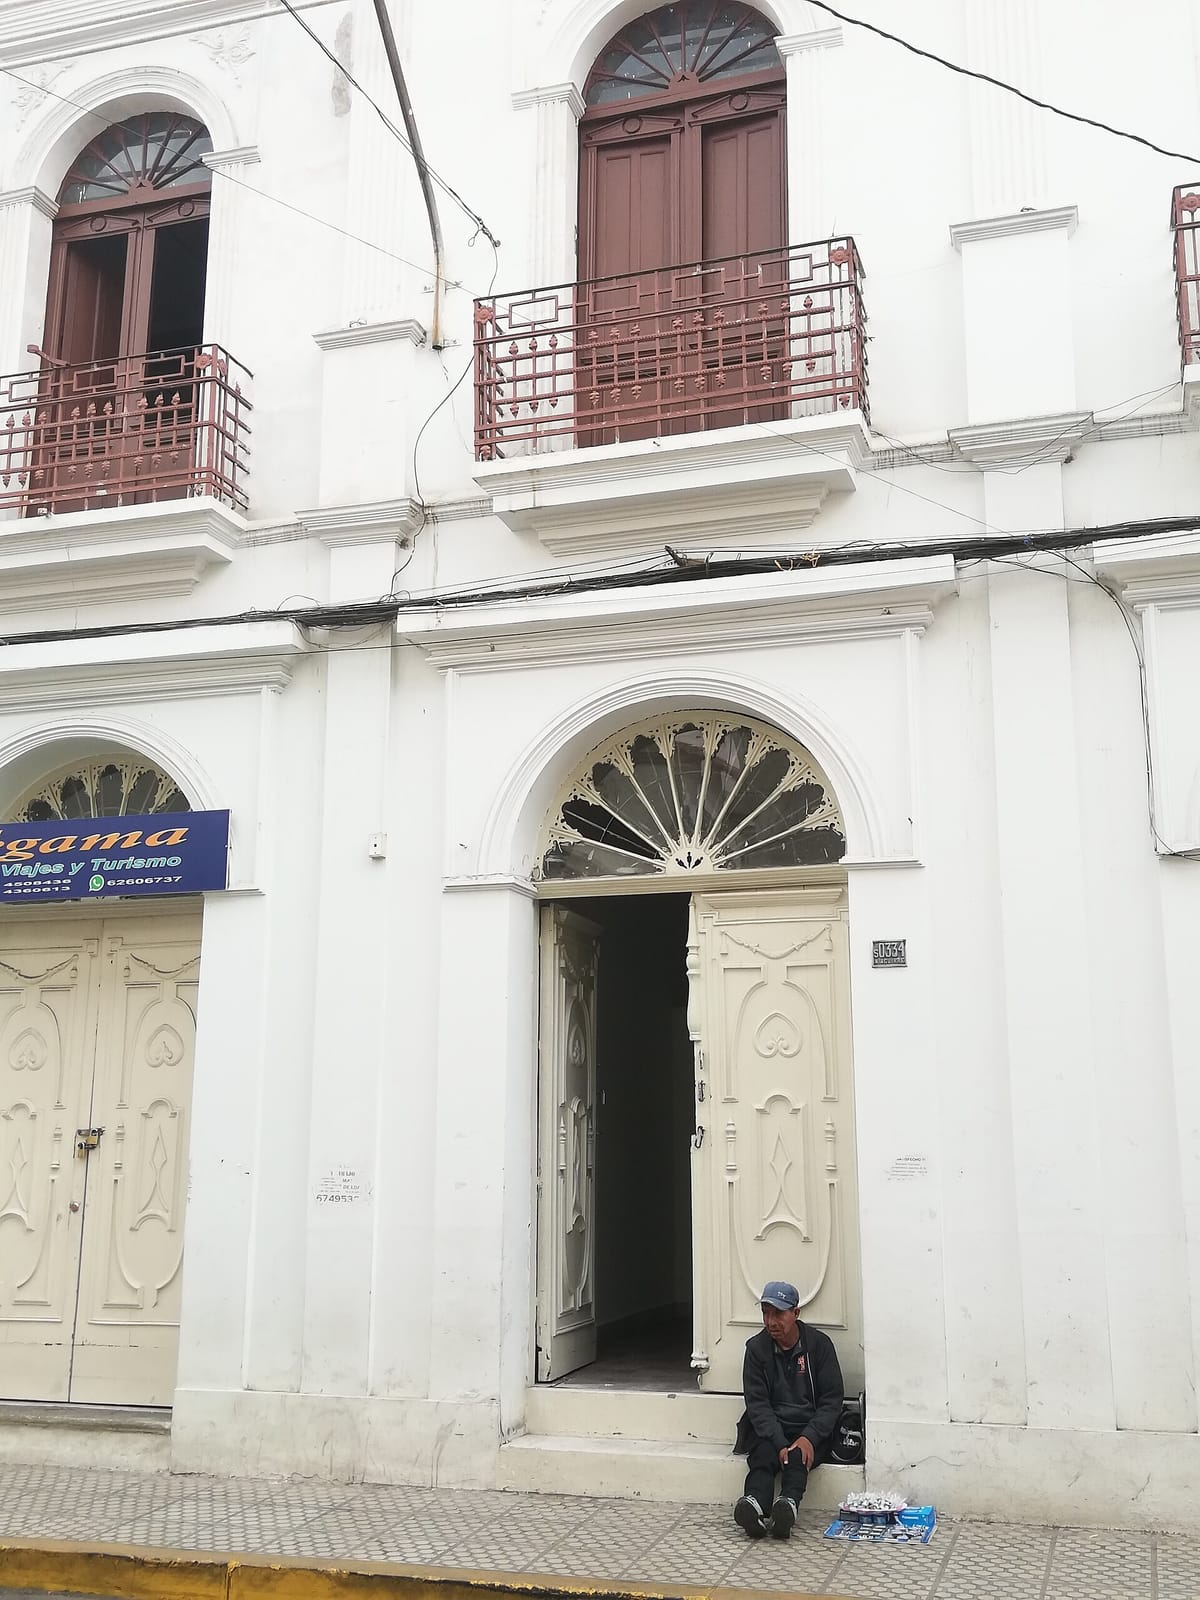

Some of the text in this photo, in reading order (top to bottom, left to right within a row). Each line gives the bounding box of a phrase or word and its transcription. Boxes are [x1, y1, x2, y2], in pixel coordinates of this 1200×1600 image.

[0, 827, 189, 862] gama
[1, 856, 182, 878] Viajes y Turismo
[107, 876, 182, 886] 62606737
